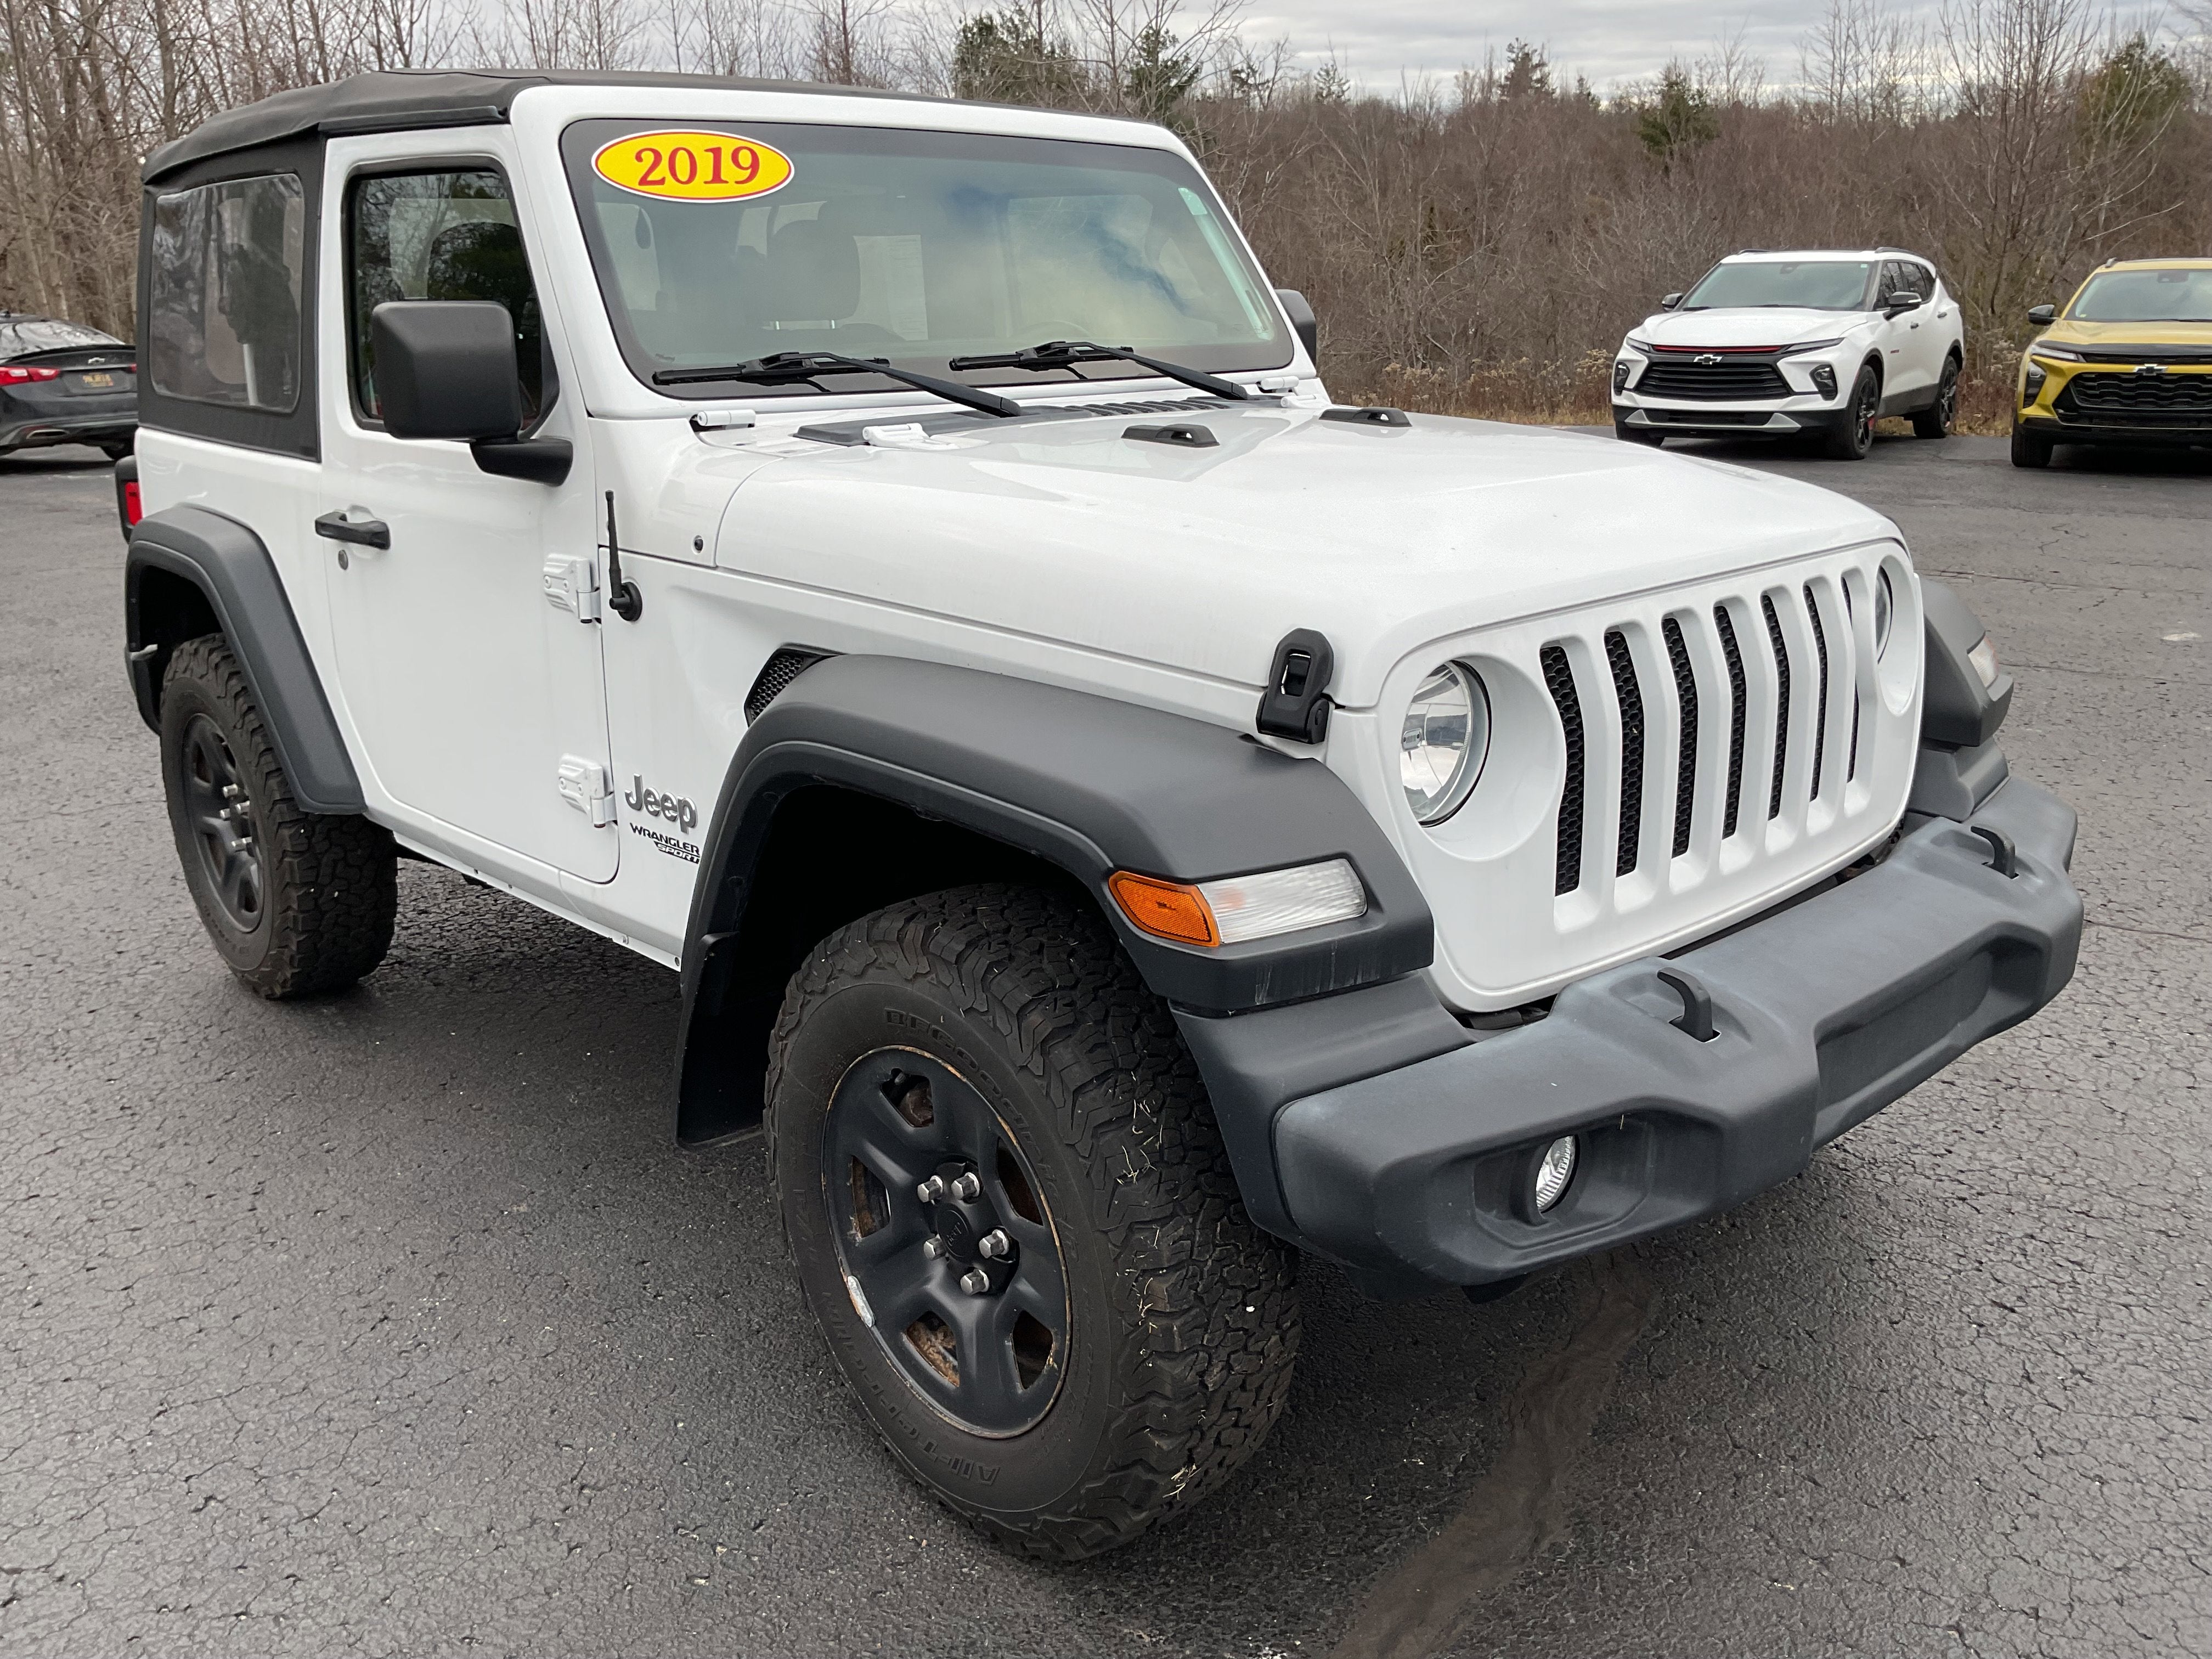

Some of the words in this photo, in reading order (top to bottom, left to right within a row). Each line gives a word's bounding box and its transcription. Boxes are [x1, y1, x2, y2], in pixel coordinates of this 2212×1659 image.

[635, 146, 760, 186] 2019
[624, 773, 698, 834] Jeep
[629, 822, 700, 856] WRANGLER
[657, 843, 700, 864] SPORT
